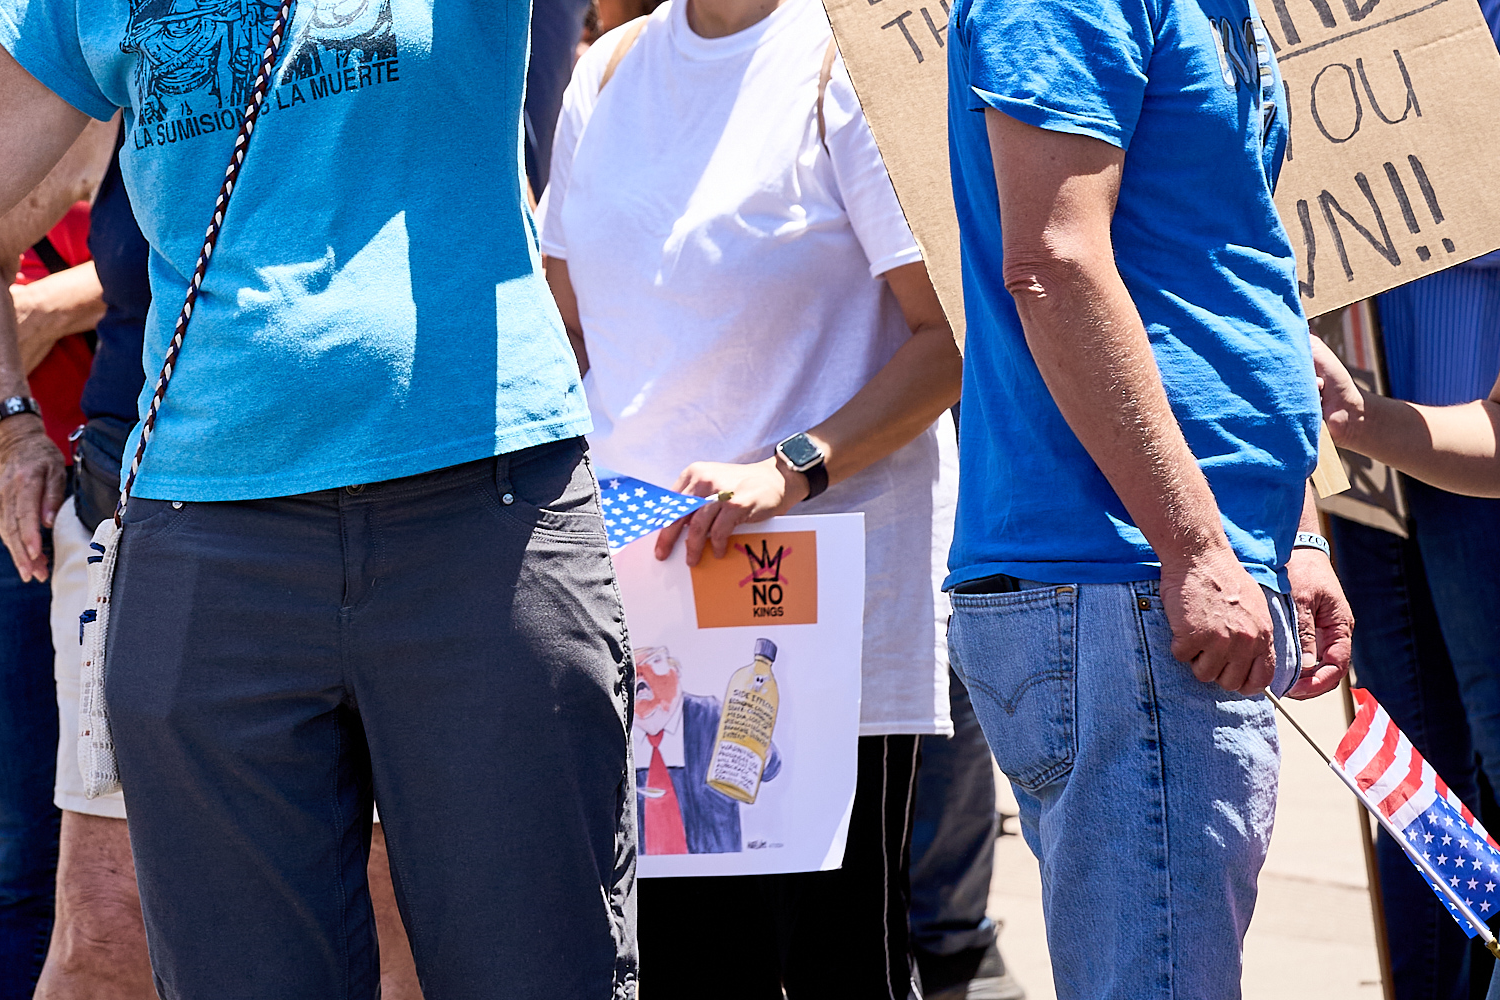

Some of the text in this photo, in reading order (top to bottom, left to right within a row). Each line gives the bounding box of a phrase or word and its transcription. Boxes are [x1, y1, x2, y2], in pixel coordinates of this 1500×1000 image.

[134, 128, 154, 150] LA
[276, 83, 306, 110] LA
[312, 60, 399, 99] MUERTE
[752, 583, 783, 605] NO
[753, 606, 784, 617] KINGS
